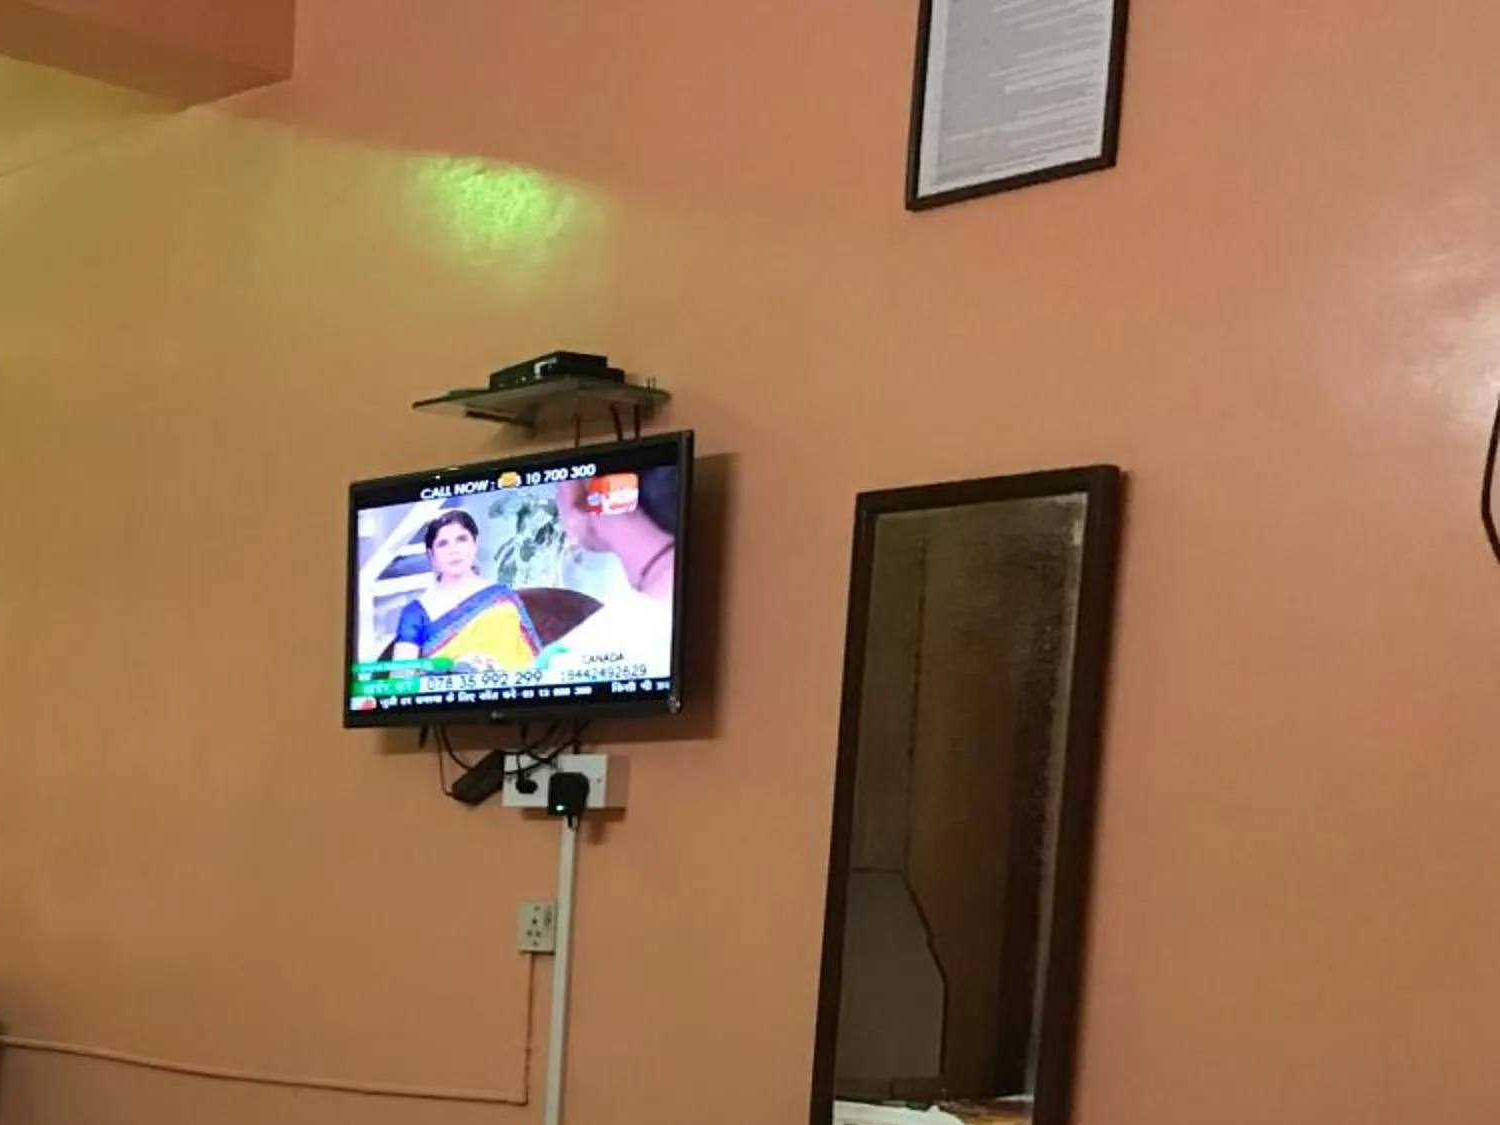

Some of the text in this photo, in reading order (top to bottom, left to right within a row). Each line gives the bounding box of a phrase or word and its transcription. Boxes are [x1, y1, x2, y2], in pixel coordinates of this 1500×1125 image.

[420, 485, 452, 500] CALL
[454, 480, 488, 495] NOW
[526, 471, 540, 485] 10
[544, 467, 568, 482] 700
[571, 464, 596, 479] 300
[581, 652, 625, 665] CANADA
[481, 671, 508, 687] 992
[515, 669, 543, 685] 299
